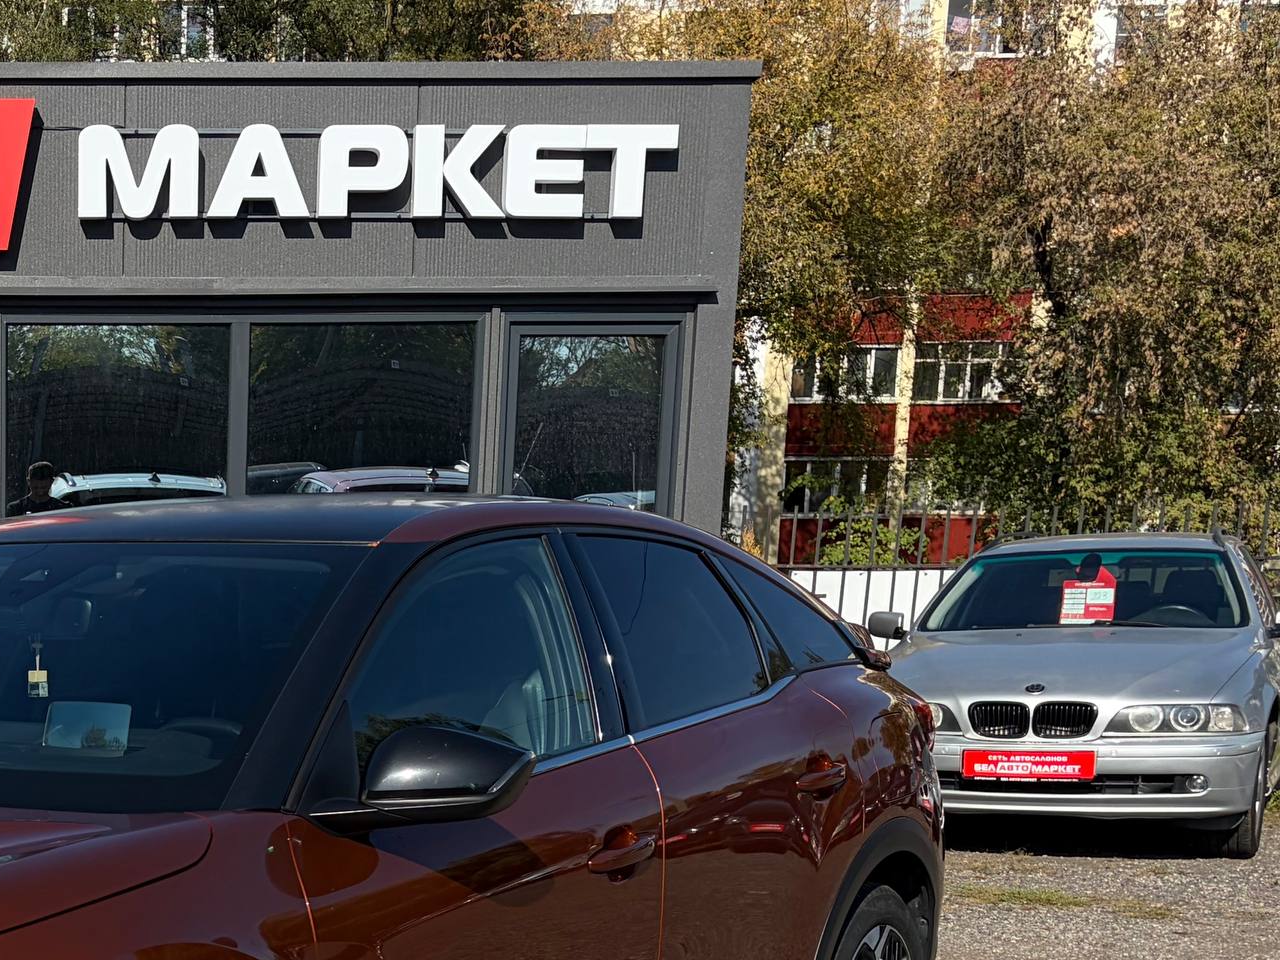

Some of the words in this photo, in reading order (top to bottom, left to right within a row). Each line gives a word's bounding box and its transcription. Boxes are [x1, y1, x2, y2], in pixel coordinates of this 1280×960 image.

[77, 124, 680, 220] МАРКЕТ
[973, 763, 996, 773] БЕЛ
[999, 763, 1029, 772] АВТО
[1031, 764, 1081, 773] МАРКЕТ
